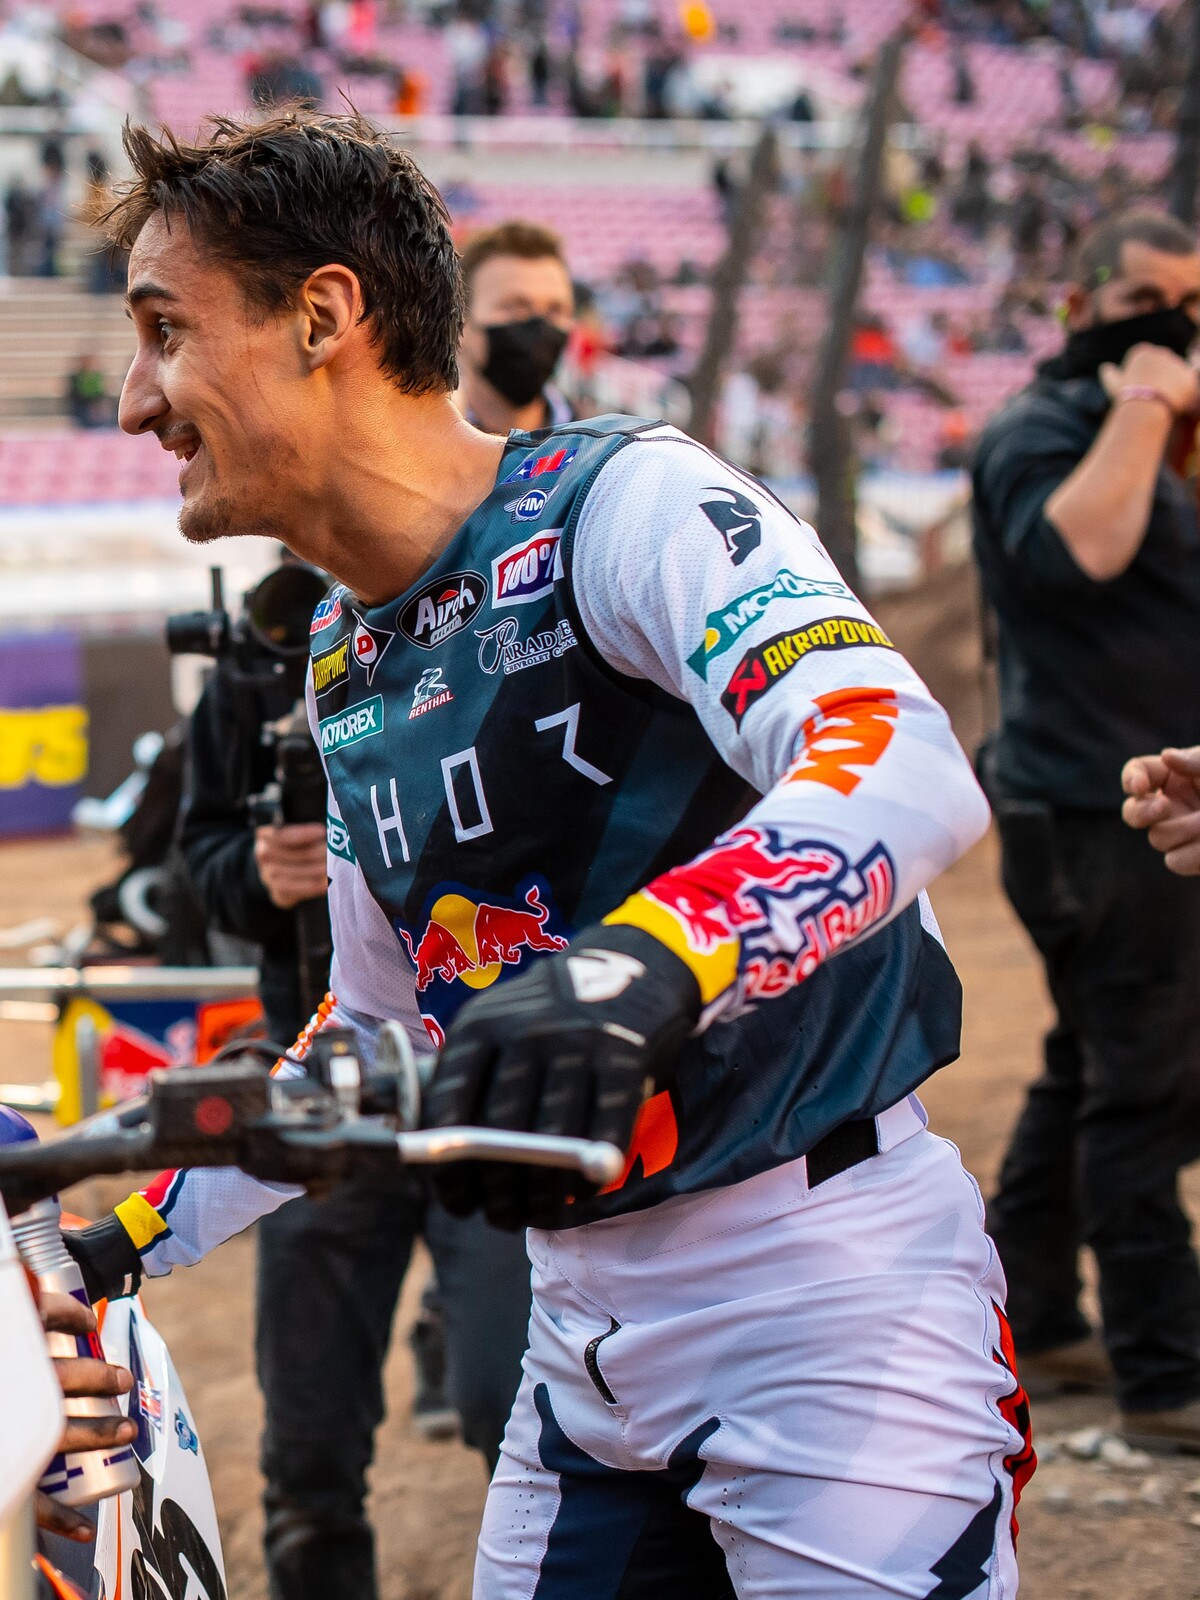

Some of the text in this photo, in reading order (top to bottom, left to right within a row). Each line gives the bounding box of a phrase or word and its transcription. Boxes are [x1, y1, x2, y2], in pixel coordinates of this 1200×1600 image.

[518, 498, 544, 511] FIM
[504, 652, 550, 674] CHEVROLET
[408, 689, 454, 720] RENTHAL
